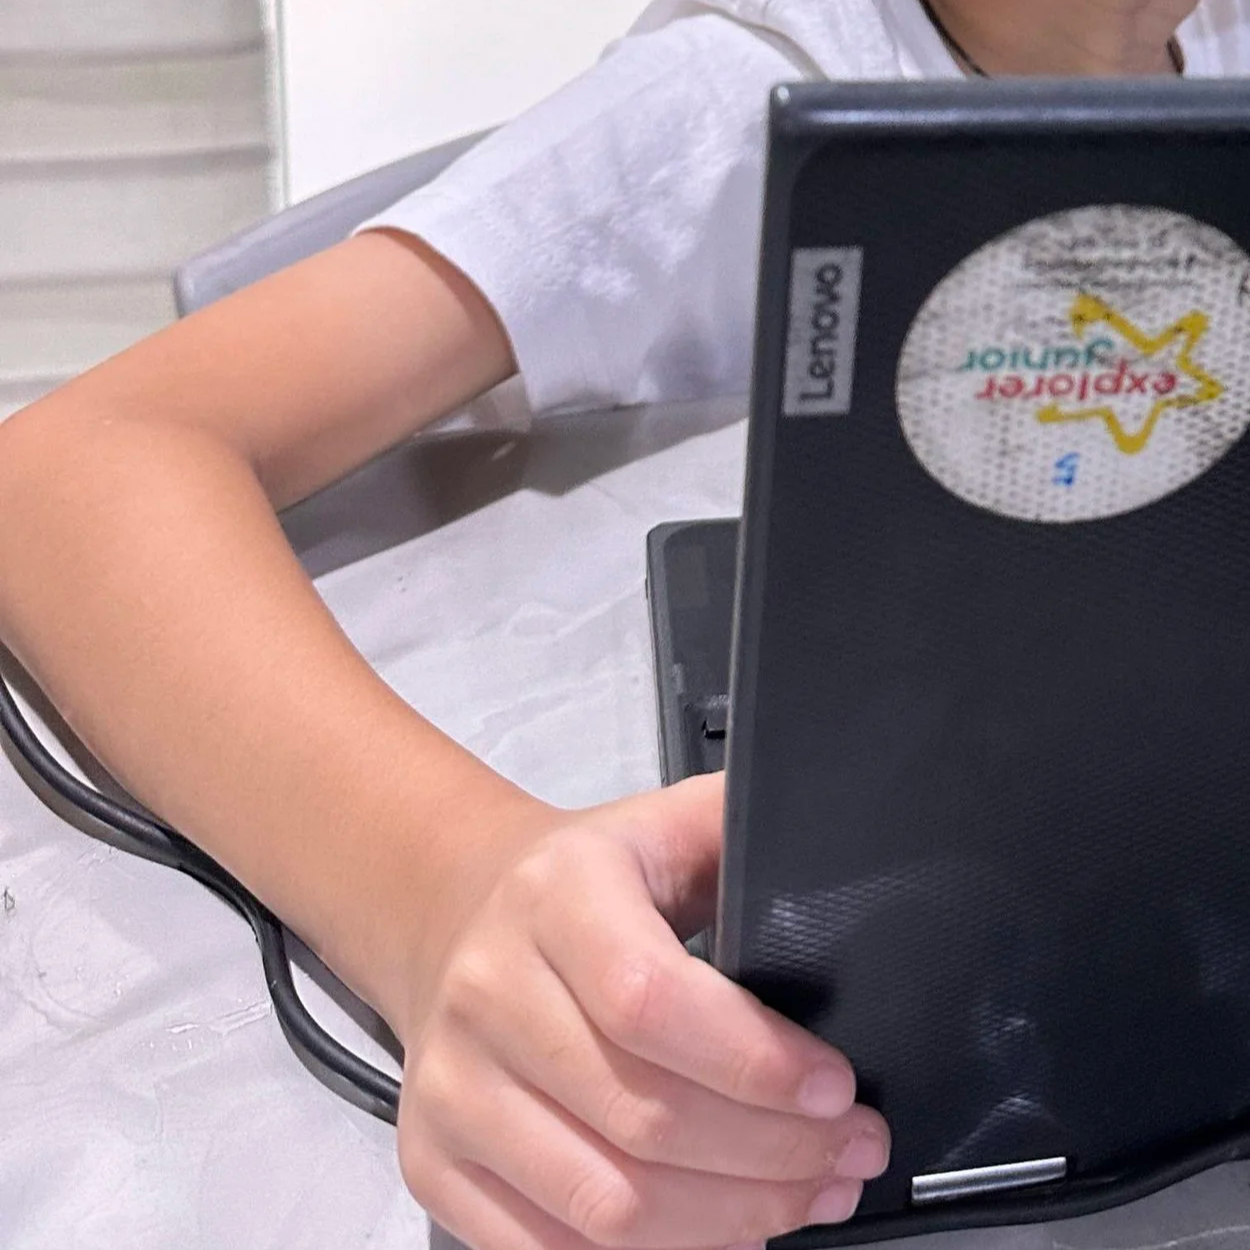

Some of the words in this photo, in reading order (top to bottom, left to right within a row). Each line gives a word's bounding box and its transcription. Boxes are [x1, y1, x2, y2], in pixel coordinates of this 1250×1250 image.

[799, 262, 844, 403] Lenovo
[958, 337, 1116, 375] junior
[974, 358, 1178, 402] explorer
